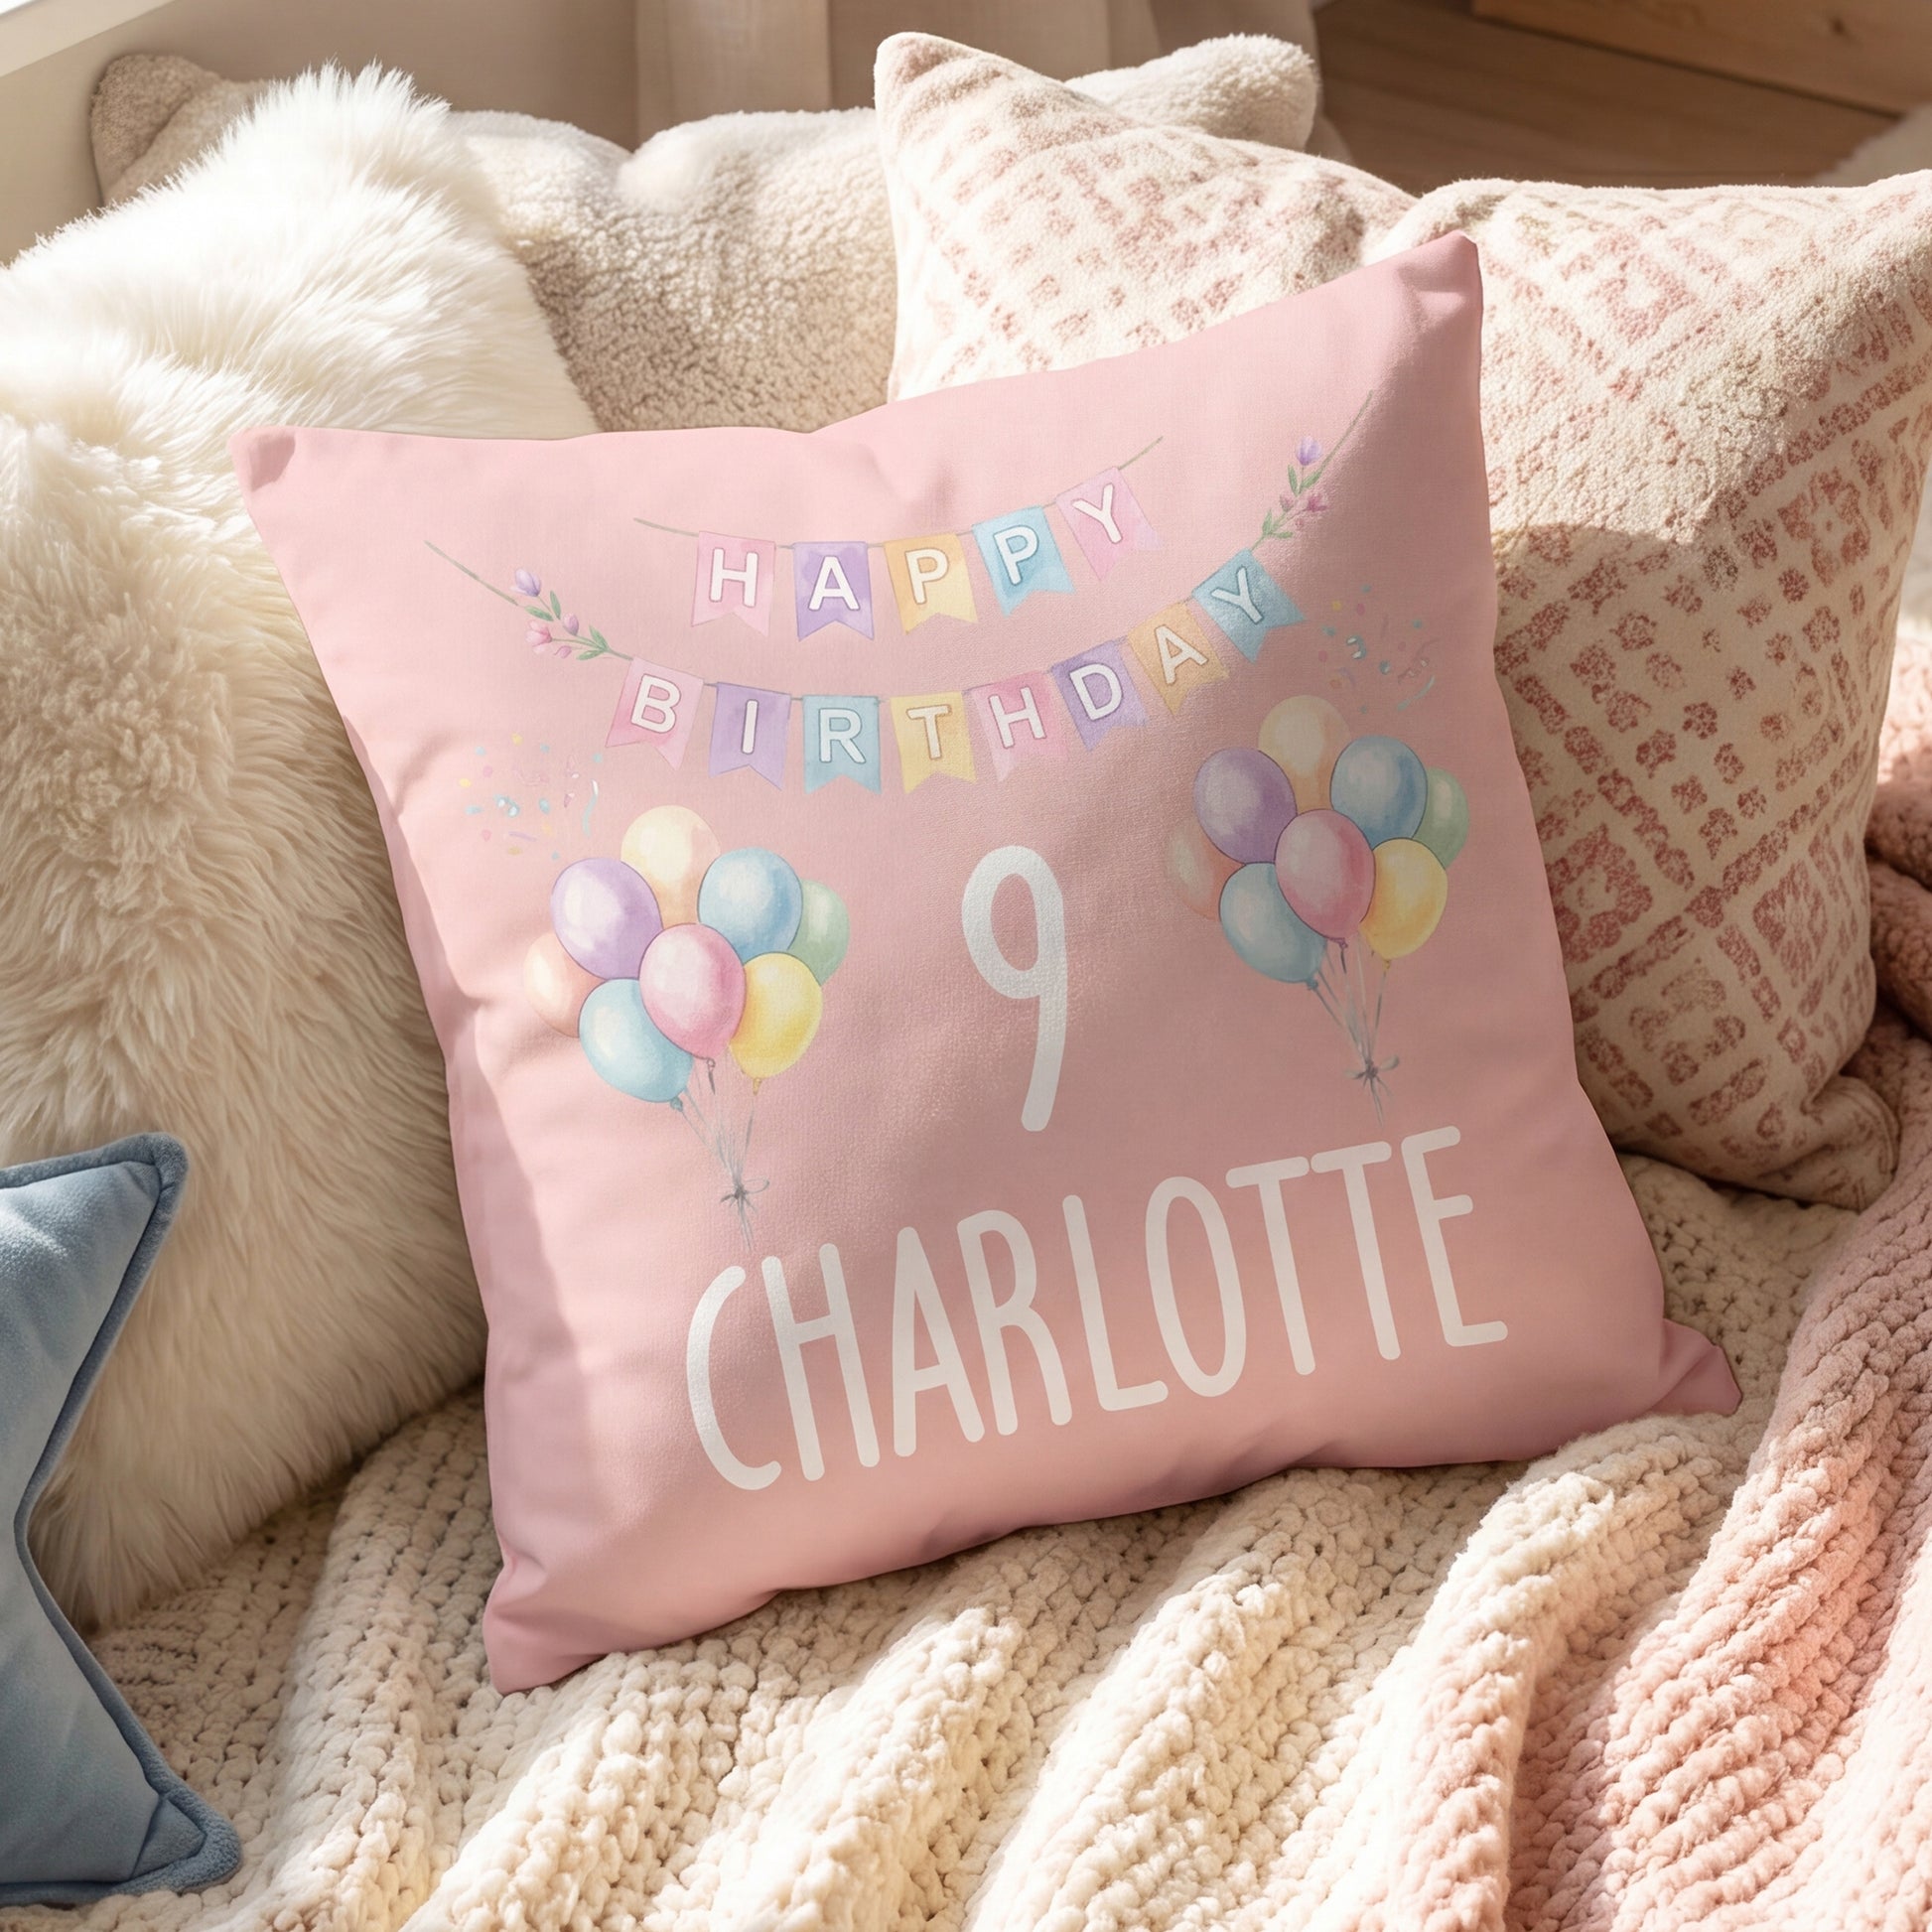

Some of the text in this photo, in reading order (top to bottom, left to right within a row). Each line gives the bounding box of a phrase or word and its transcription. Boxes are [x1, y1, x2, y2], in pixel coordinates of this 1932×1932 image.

[629, 566, 1264, 764] BIRTHDAY
[708, 483, 1121, 613] HAPPY
[960, 845, 1068, 1132] 9
[685, 1125, 1508, 1491] CHARLOTTE
